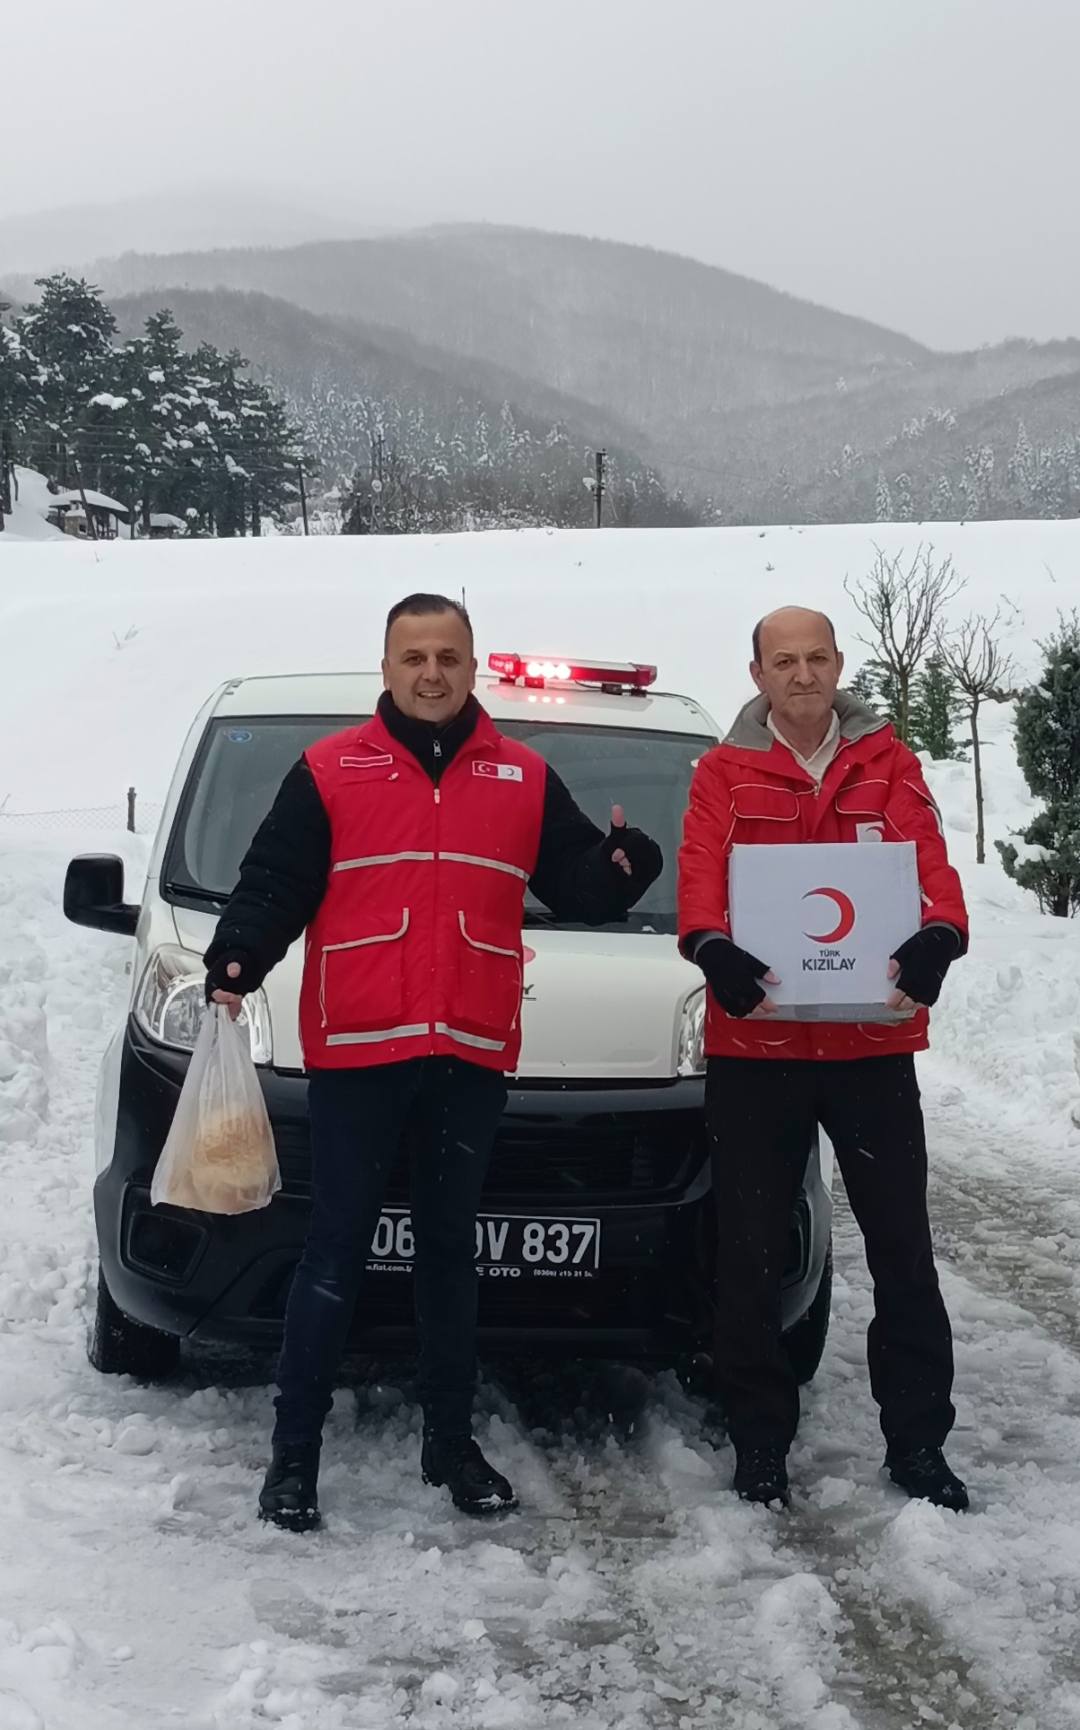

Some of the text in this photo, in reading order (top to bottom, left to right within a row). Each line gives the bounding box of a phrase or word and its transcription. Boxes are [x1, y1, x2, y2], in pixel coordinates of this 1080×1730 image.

[819, 949, 841, 957] TÜRK
[802, 958, 856, 971] KIZILAY
[371, 1216, 416, 1257] 06
[522, 1222, 594, 1263] 837
[489, 1267, 521, 1277] OTO
